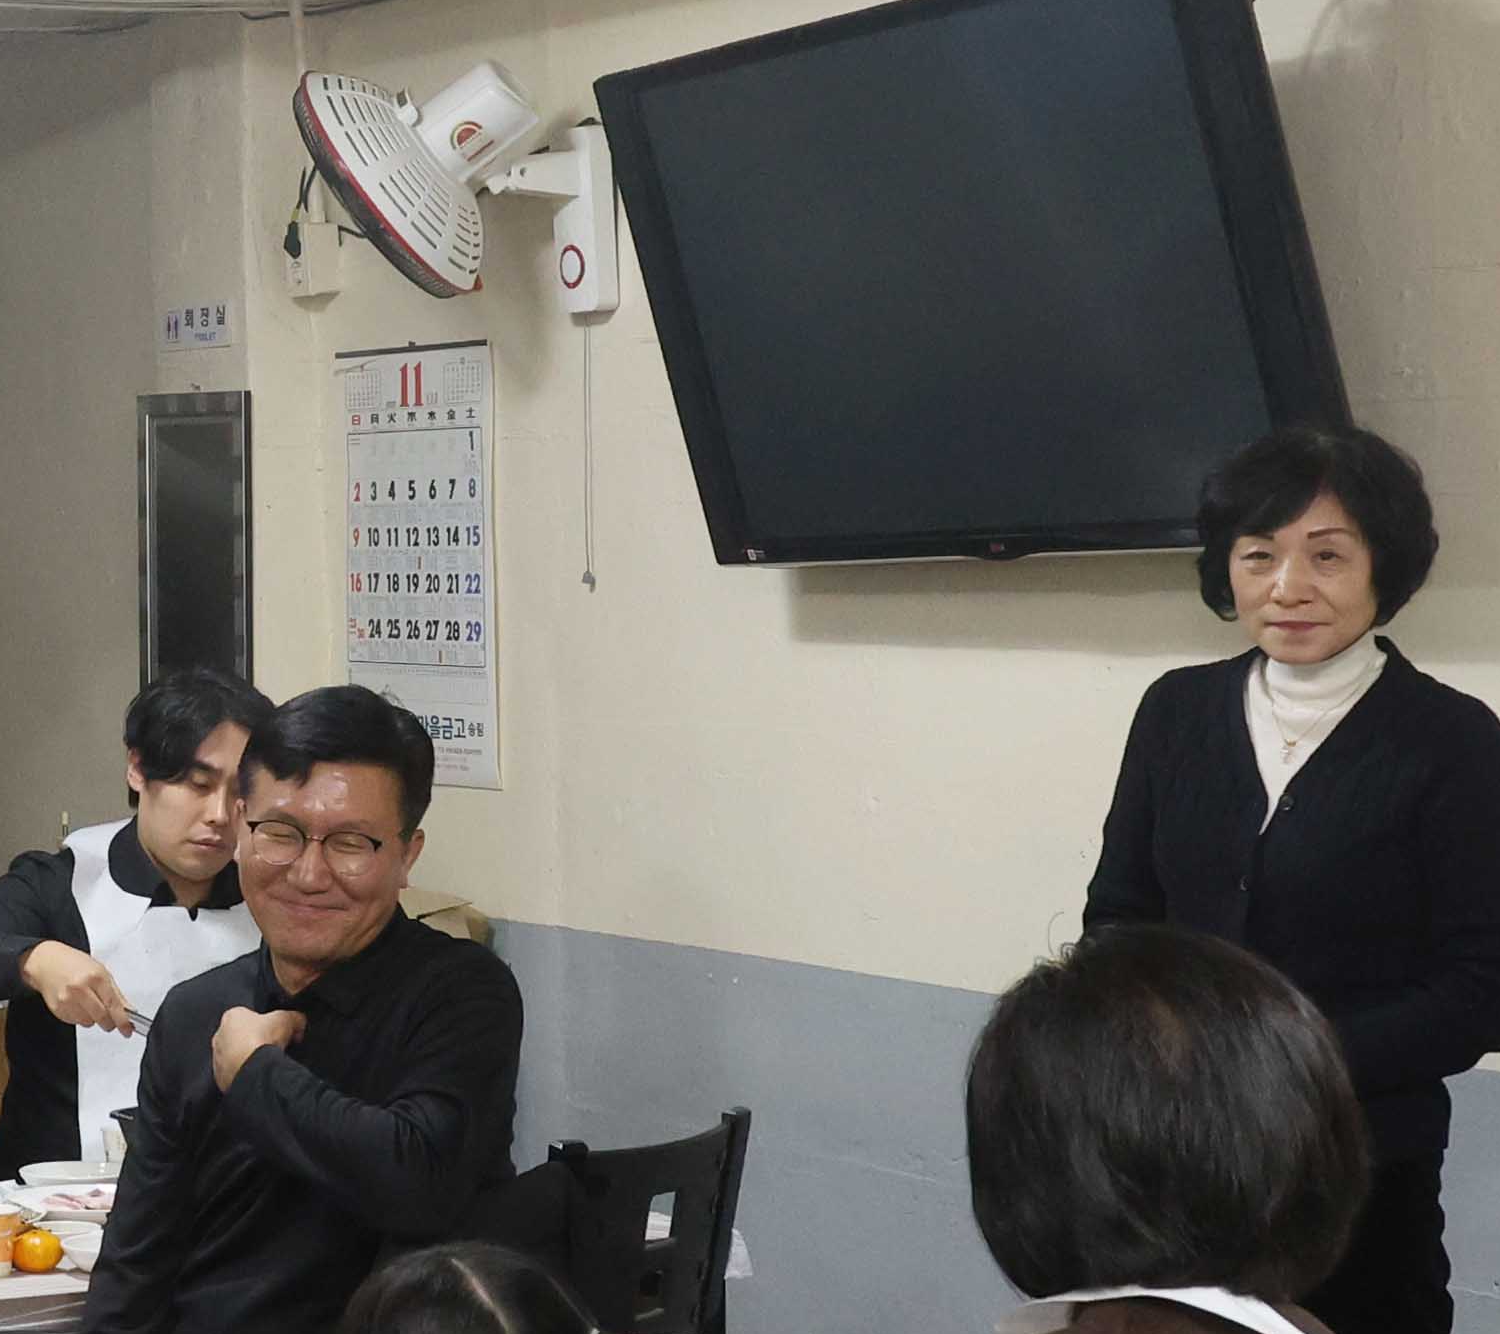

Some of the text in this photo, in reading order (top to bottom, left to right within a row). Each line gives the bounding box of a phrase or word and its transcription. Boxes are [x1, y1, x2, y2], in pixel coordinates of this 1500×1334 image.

[184, 304, 227, 329] 화장실
[399, 361, 424, 408] 11
[468, 430, 475, 451] 1
[353, 478, 477, 502] 2 3 4 5 6 7 8
[352, 525, 481, 547] 9 10 11 12 13 14 15
[350, 573, 481, 594] 16 17 18 19 20 21 22
[368, 619, 382, 639] 24
[386, 619, 400, 639] 25
[406, 619, 420, 640] 26
[425, 620, 440, 640] 27
[446, 620, 460, 641] 28
[465, 620, 481, 642] 29
